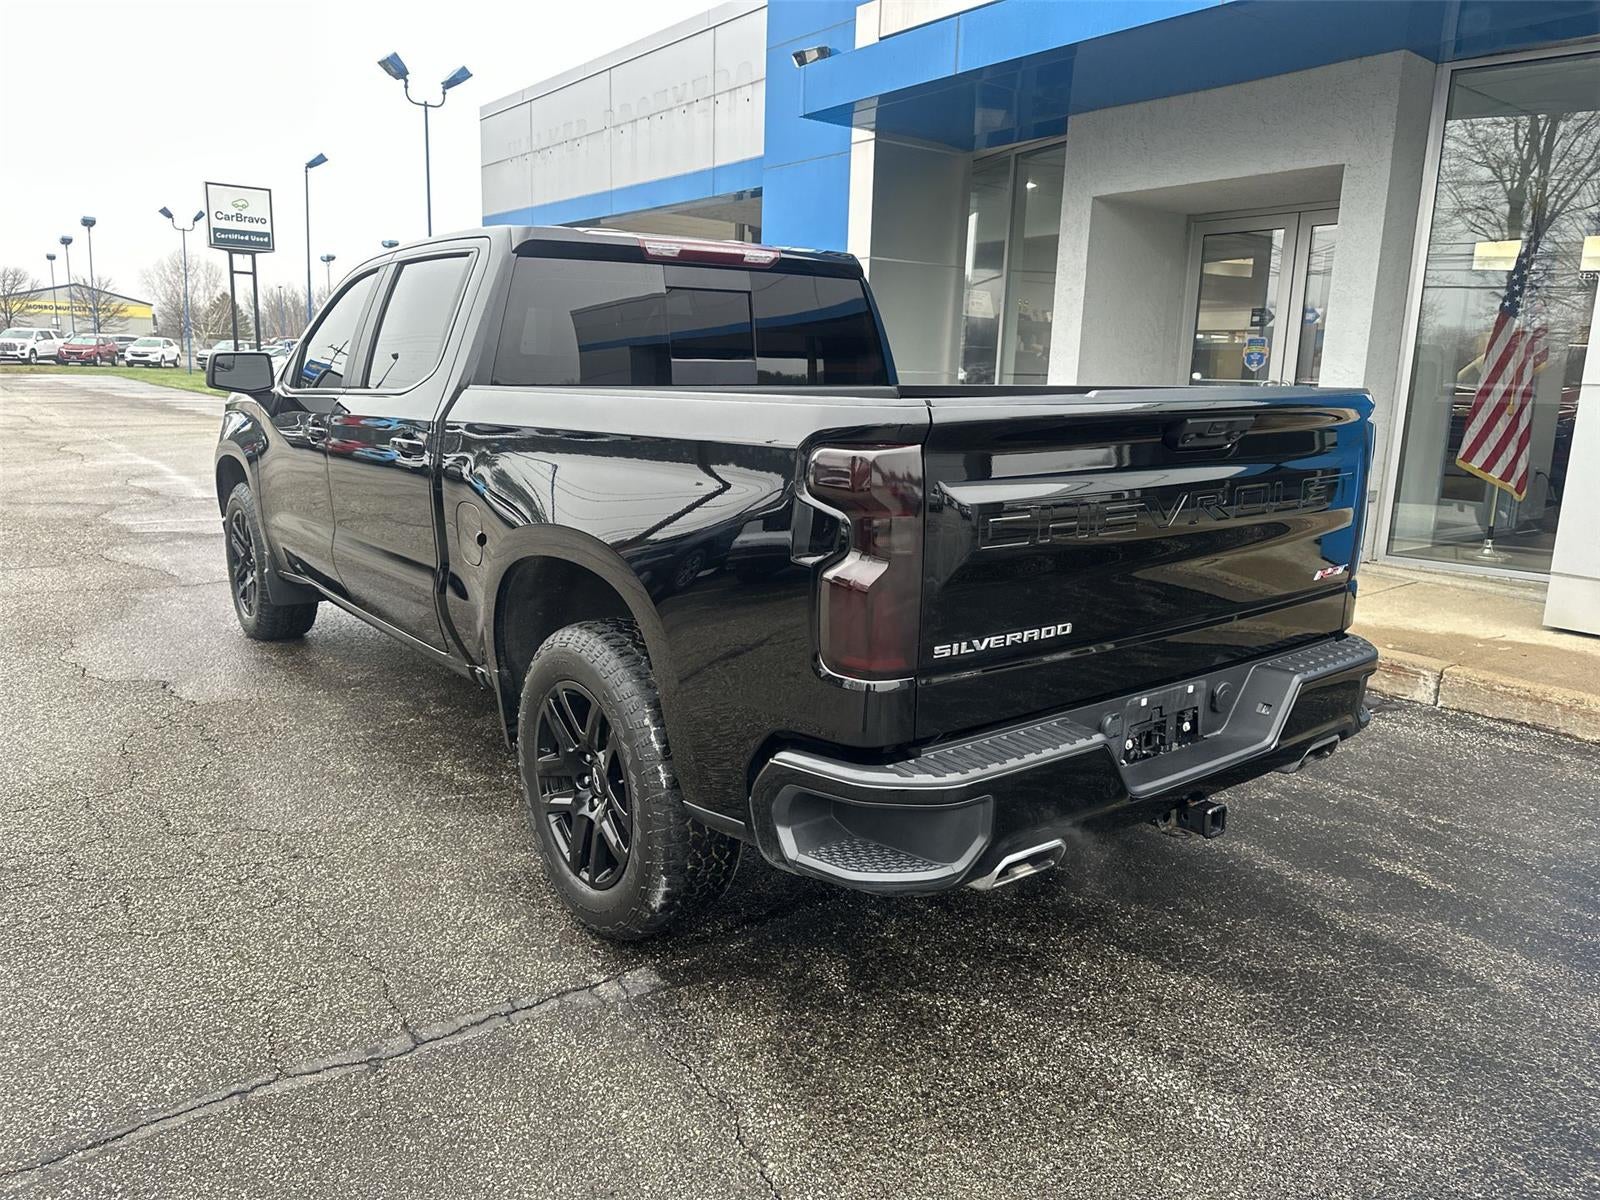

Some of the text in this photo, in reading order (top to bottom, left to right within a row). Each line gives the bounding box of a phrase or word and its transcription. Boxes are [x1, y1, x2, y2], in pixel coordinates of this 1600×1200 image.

[214, 210, 267, 225] CarBravo
[215, 231, 249, 241] Certified
[932, 622, 1073, 659] SILVERADO
